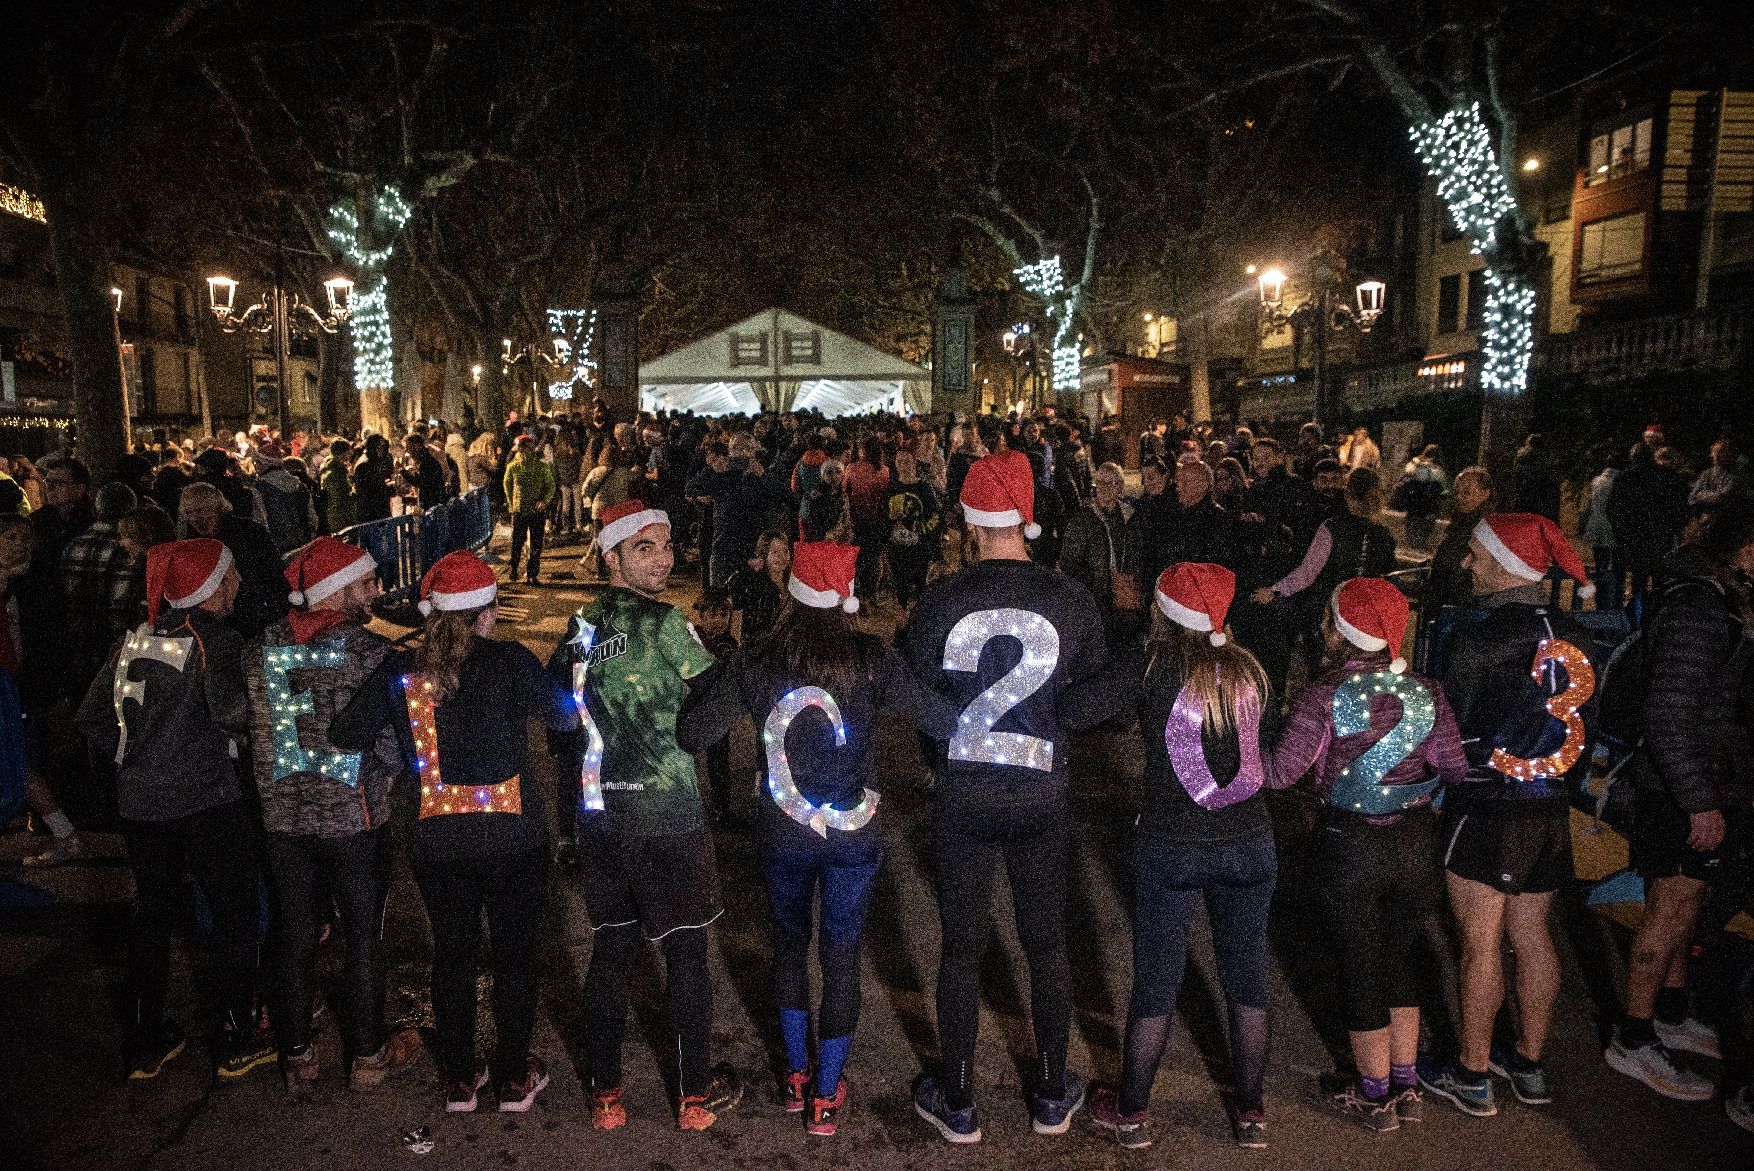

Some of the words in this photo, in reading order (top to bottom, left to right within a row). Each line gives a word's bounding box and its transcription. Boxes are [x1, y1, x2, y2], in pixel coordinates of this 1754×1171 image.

[114, 629, 194, 765] F
[262, 638, 362, 788] E
[402, 672, 522, 820] L
[943, 607, 1060, 772] 2
[1332, 670, 1440, 814] 2
[1488, 638, 1595, 781] 3
